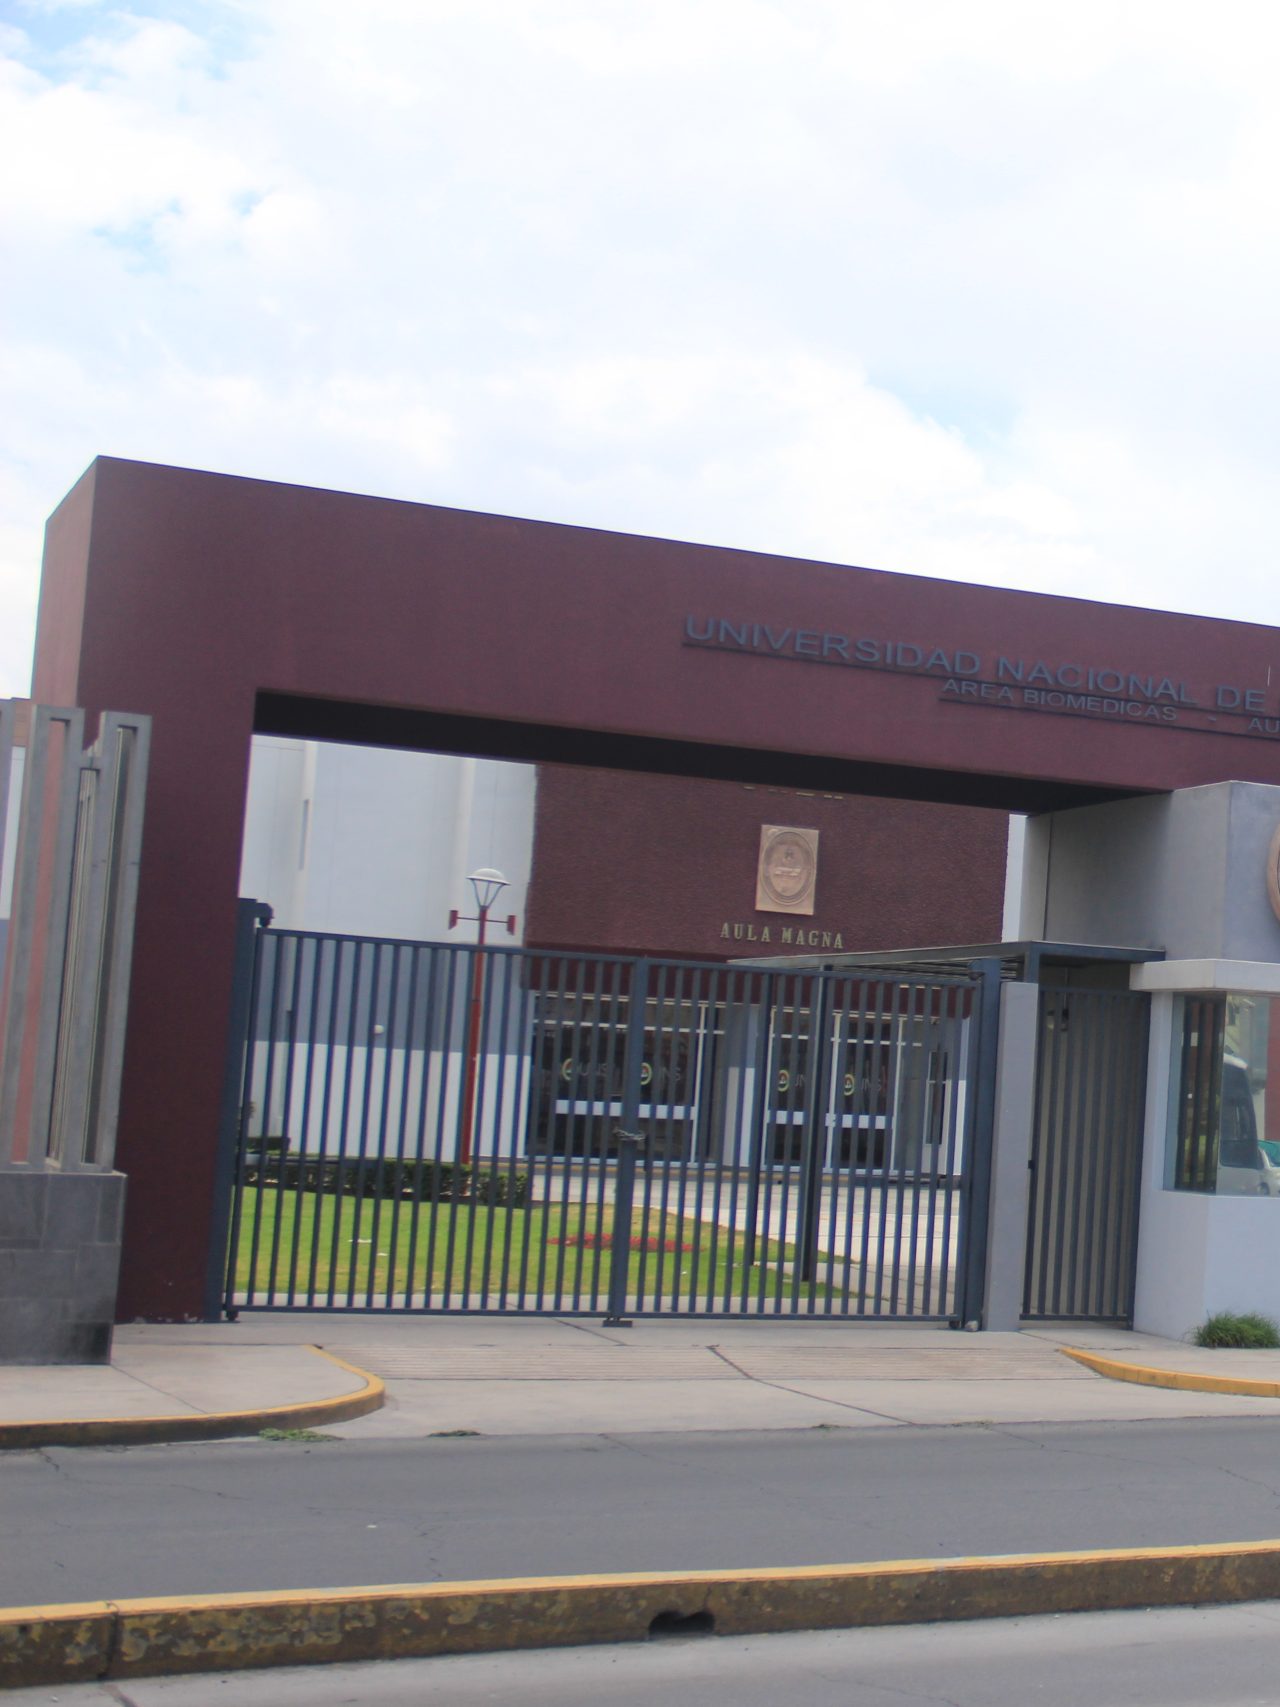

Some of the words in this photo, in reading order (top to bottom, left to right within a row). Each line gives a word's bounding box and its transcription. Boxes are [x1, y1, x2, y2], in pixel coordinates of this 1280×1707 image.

[684, 614, 982, 675] UNIVERSIDAD
[996, 656, 1199, 706] NACIONAL
[1216, 684, 1267, 717] DE
[941, 678, 1014, 702] AREA
[1024, 688, 1179, 722] BIOMEDICAS
[719, 922, 771, 943] AULA
[781, 927, 844, 949] MAGNA
